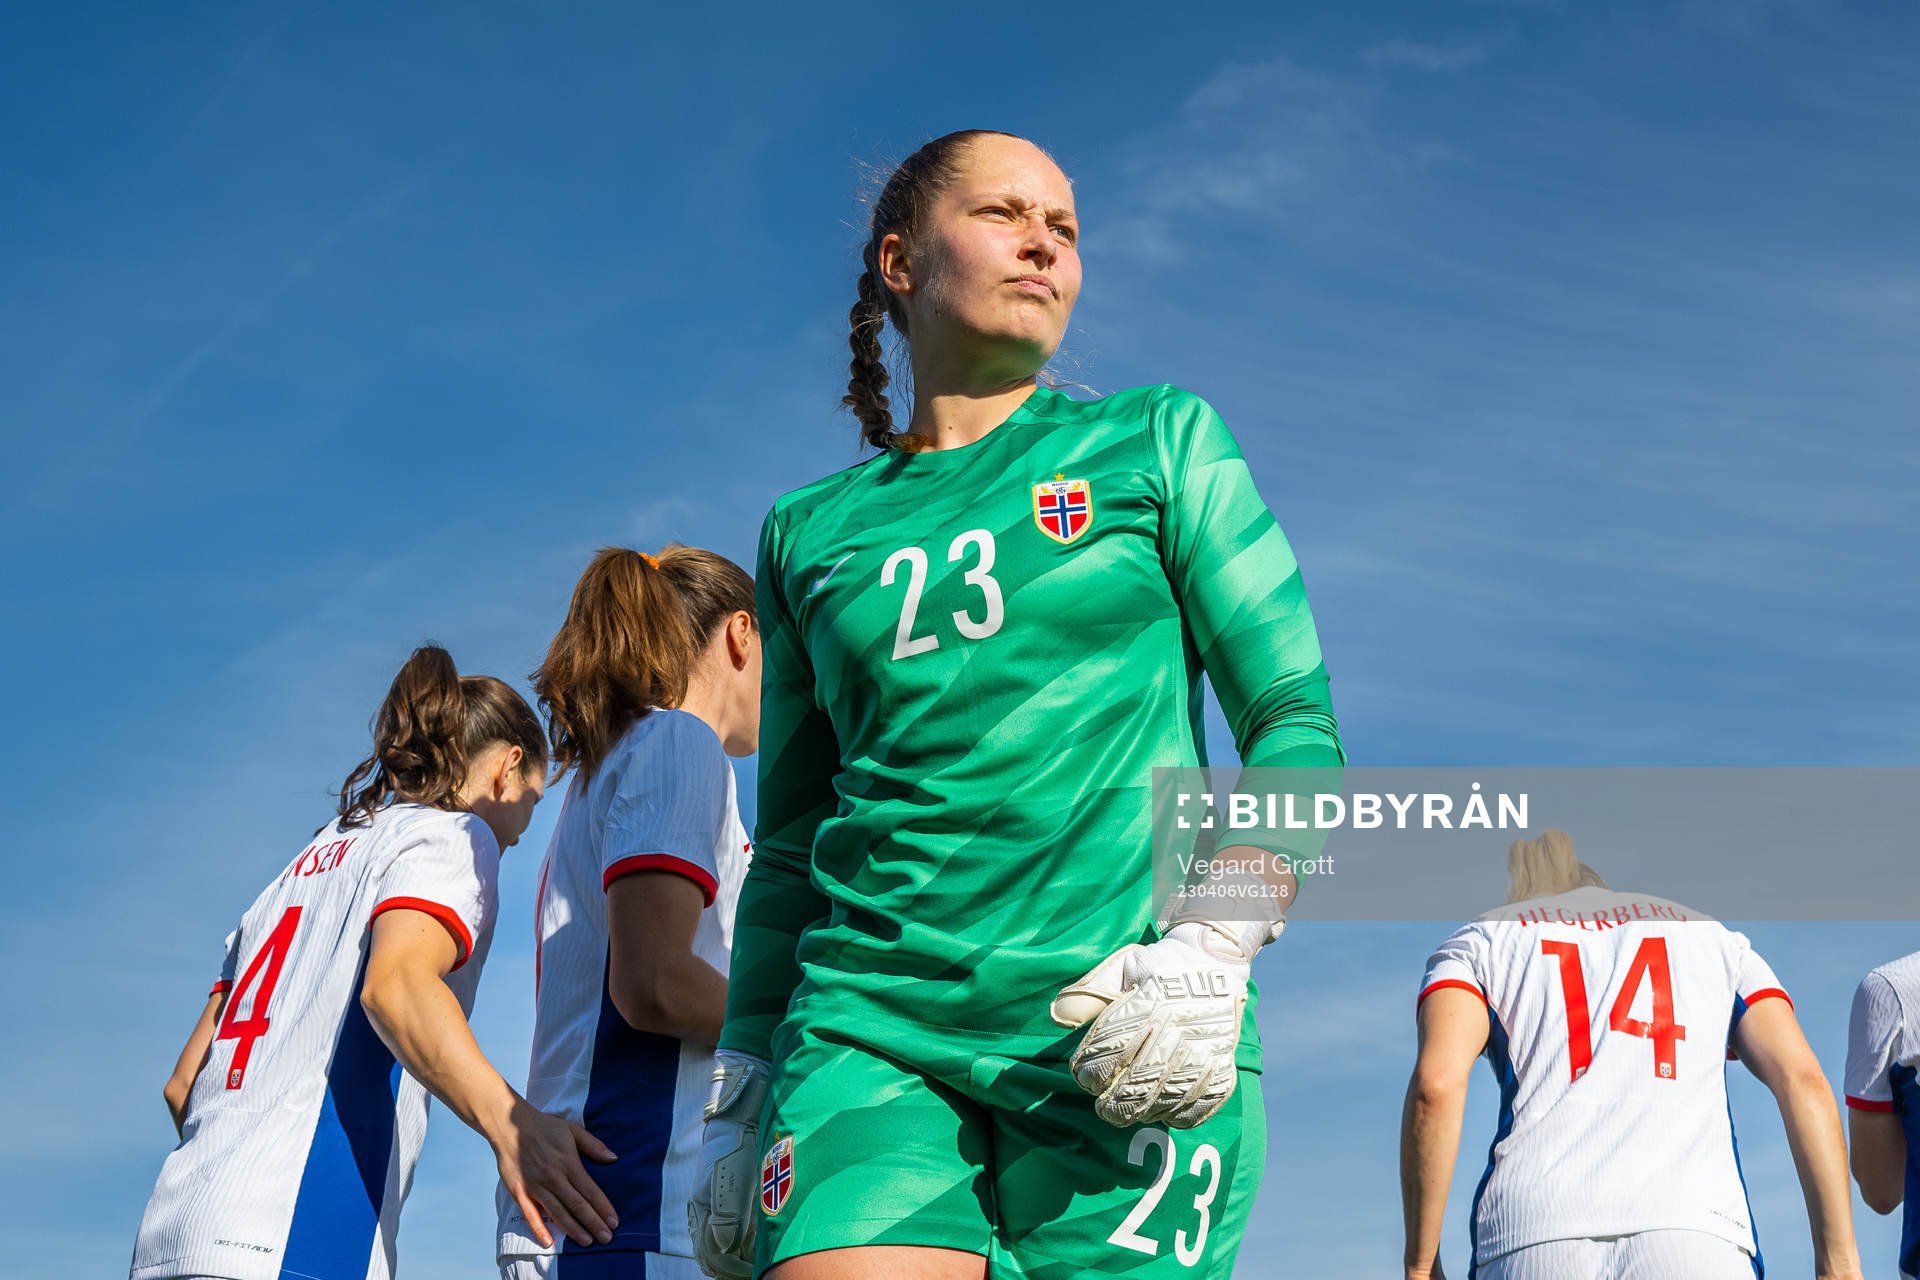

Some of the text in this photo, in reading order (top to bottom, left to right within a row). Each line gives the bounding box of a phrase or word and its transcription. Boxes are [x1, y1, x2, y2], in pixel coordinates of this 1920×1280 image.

[880, 529, 1004, 661] 23
[282, 837, 358, 880] NSEN
[1517, 902, 1687, 931] HEGERBERG
[216, 906, 303, 1089] 4
[1541, 937, 1685, 1084] 14
[1106, 1128, 1221, 1267] 23
